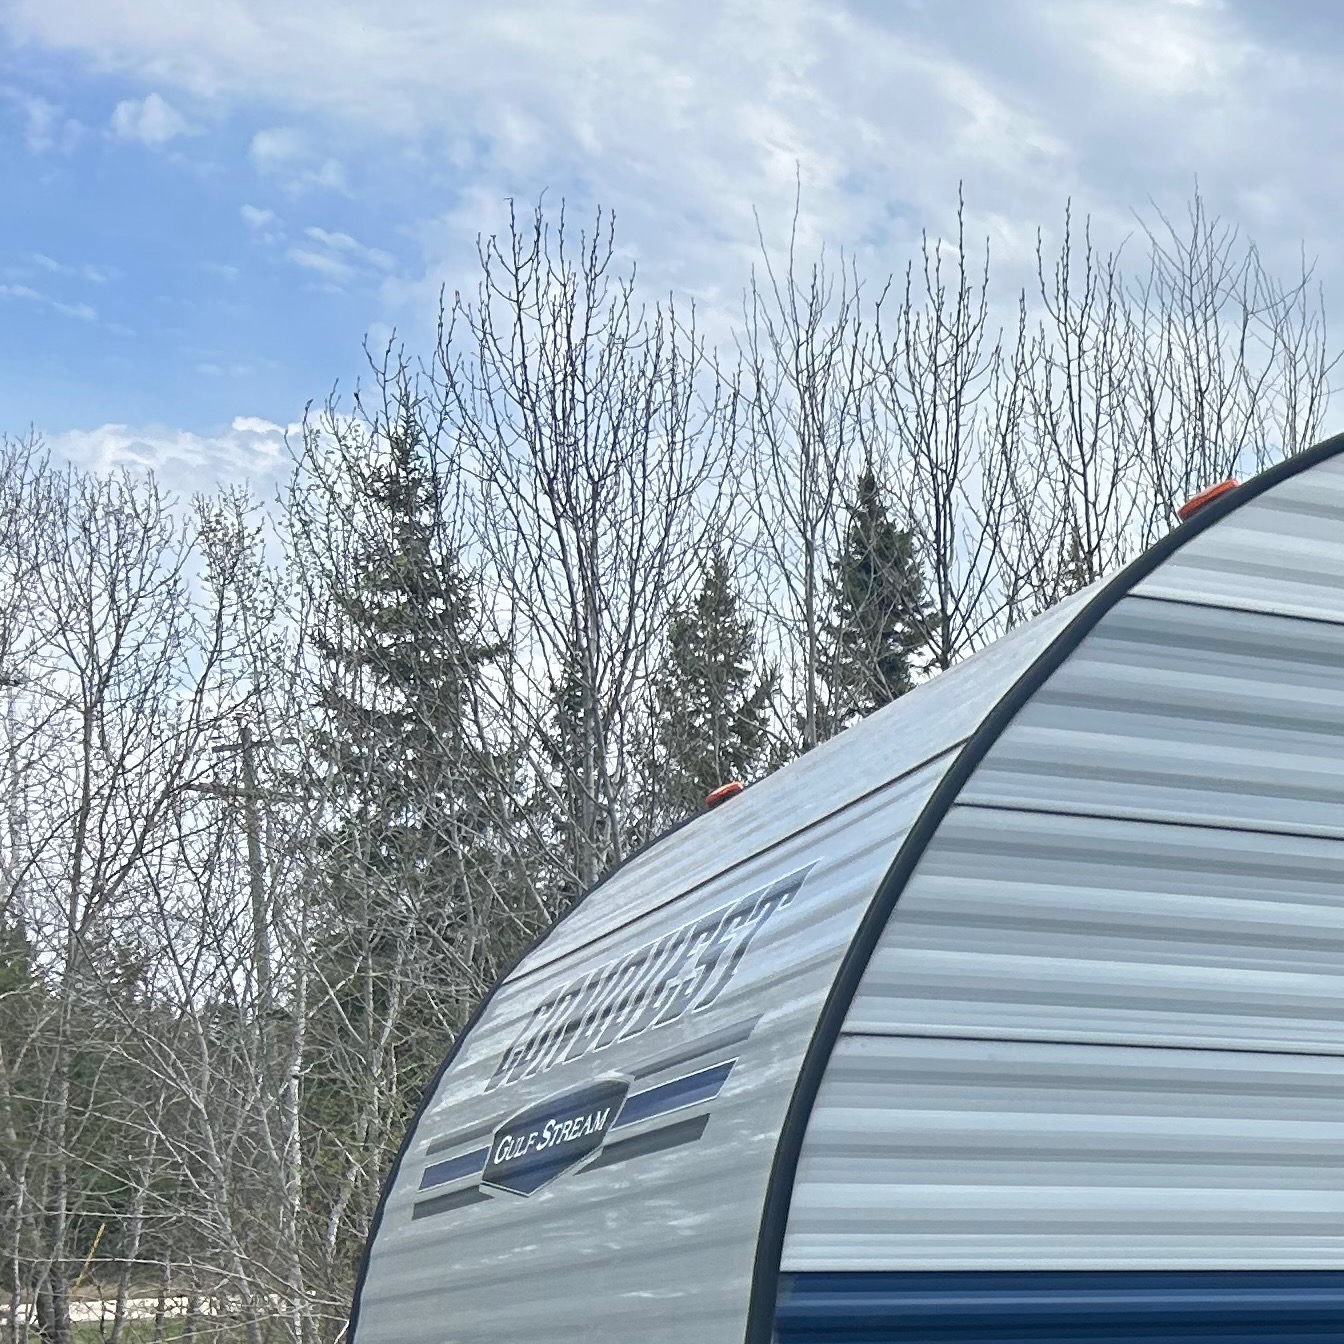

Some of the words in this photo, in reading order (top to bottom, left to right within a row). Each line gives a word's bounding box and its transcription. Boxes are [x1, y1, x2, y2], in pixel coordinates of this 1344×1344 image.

[485, 860, 820, 1093] CONQUEST
[494, 1131, 539, 1165] GULF
[536, 1107, 611, 1151] STREAM
